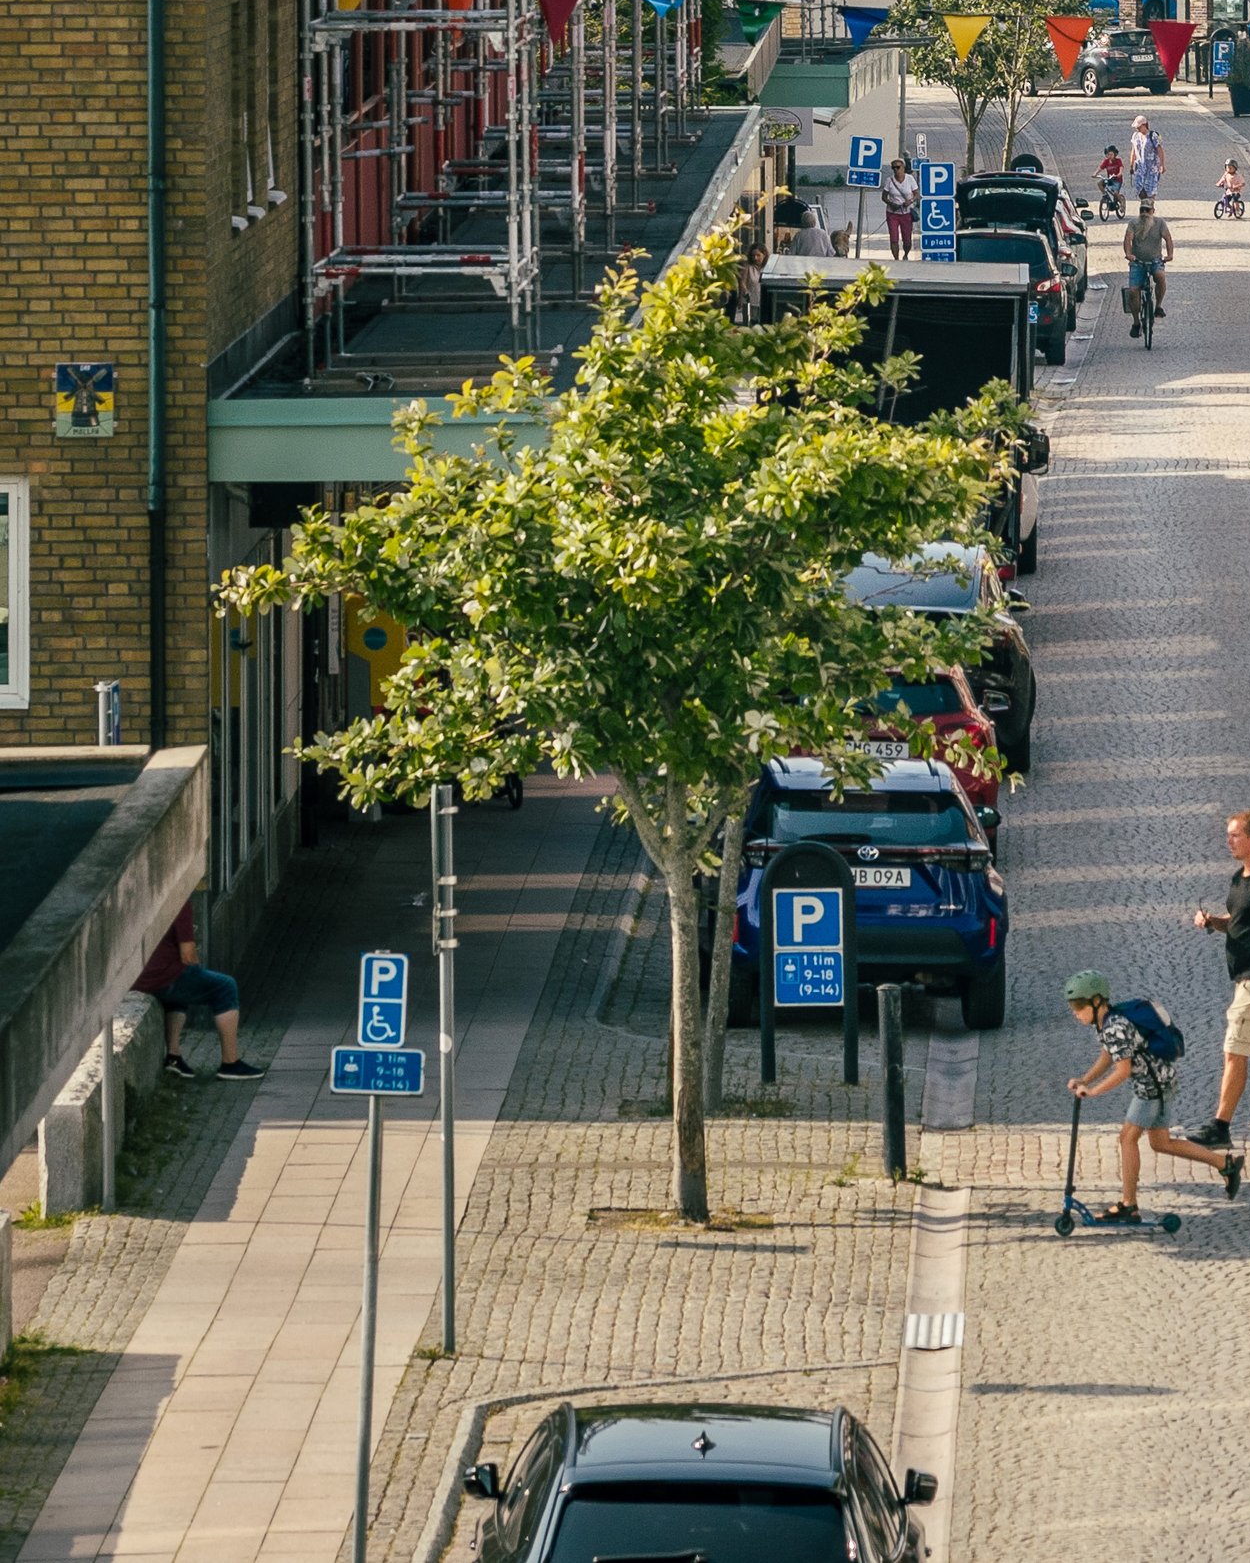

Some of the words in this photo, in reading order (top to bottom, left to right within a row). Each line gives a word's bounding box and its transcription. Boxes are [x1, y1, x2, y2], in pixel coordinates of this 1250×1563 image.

[857, 139, 877, 166] P
[929, 166, 949, 194] P
[930, 239, 952, 247] plats
[876, 743, 903, 756] 459
[874, 870, 904, 884] 09A
[793, 895, 825, 943] P
[803, 955, 807, 965] 1
[813, 954, 834, 966] tim
[371, 959, 397, 995] P
[804, 969, 833, 981] 9-18
[799, 983, 839, 996] (9-14)
[376, 1053, 382, 1063] 3
[388, 1053, 406, 1064] tim
[376, 1066, 404, 1077] 9-18
